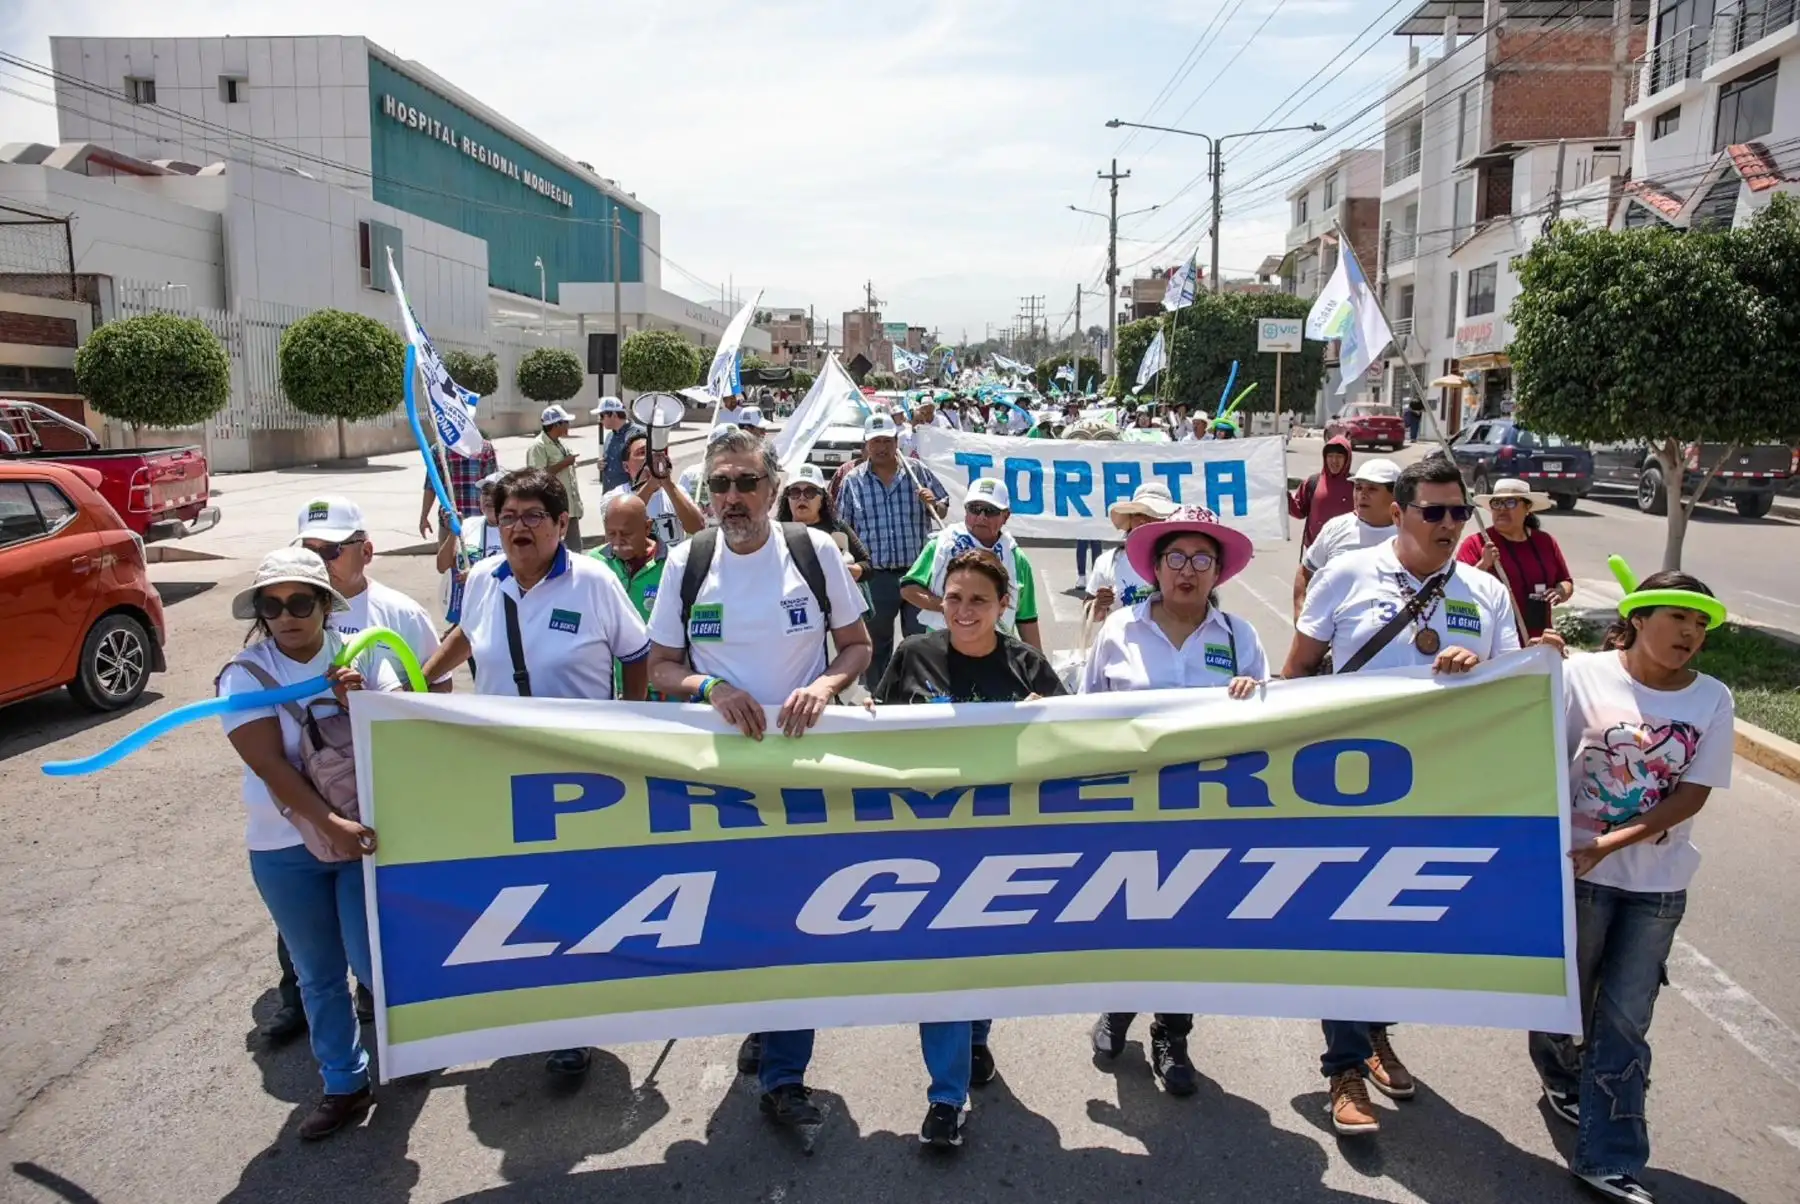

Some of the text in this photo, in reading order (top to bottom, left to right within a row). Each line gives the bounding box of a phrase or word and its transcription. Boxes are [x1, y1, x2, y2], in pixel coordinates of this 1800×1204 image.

[384, 94, 574, 208] HOSPITAL REGIONAL MOQUEGUA
[1280, 325, 1299, 335] VIC
[954, 452, 1249, 518] TORATA
[794, 610, 802, 624] 7
[1378, 601, 1398, 622] 3
[691, 622, 720, 635] LA GENTE
[1447, 616, 1480, 631] LA GENTE
[1206, 655, 1232, 669] LA GENTE
[442, 846, 1500, 968] LA GENTE
